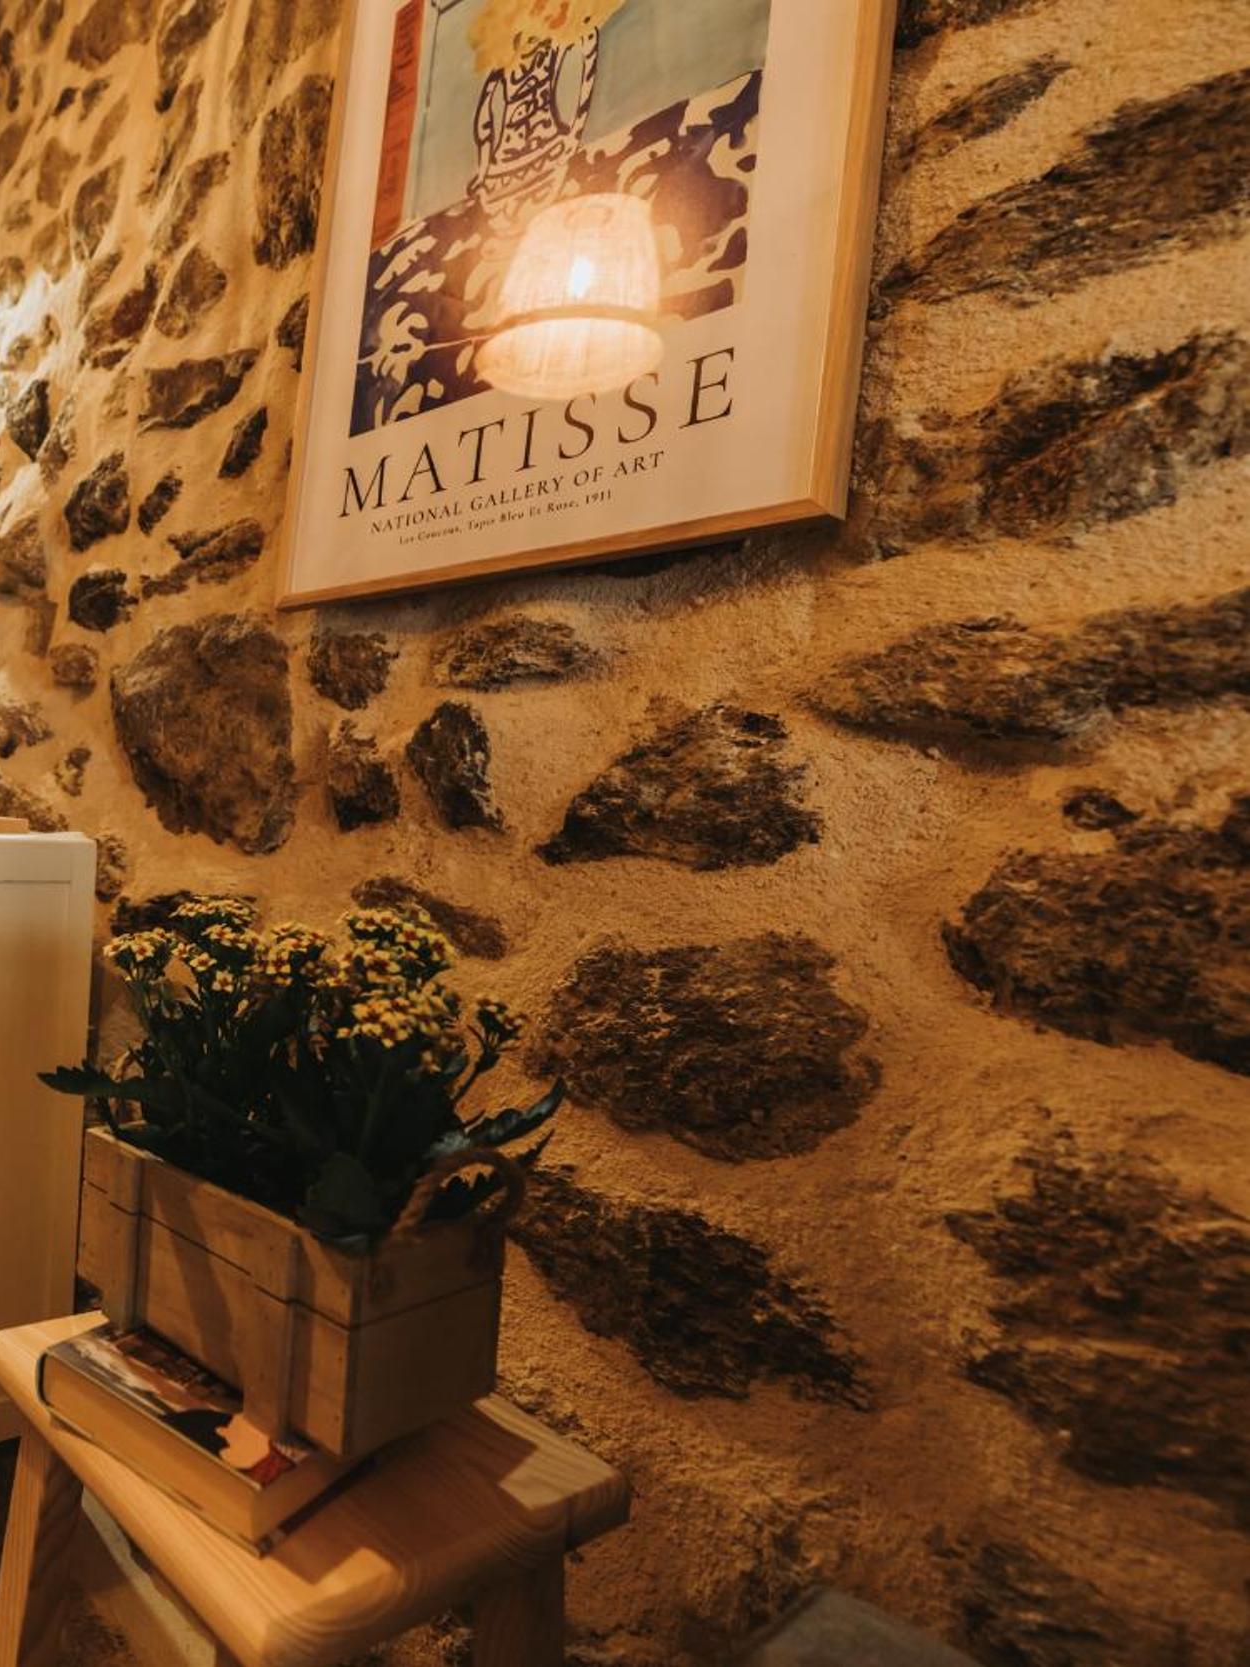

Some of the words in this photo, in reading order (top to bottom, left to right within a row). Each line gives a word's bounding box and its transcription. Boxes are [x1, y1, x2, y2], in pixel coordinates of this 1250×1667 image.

[338, 347, 735, 517] MATISSE
[371, 502, 462, 534] NATIONAL
[470, 475, 564, 511] GALLERY
[574, 466, 604, 487] OF
[613, 451, 665, 477] ART
[586, 489, 611, 505] 1911
